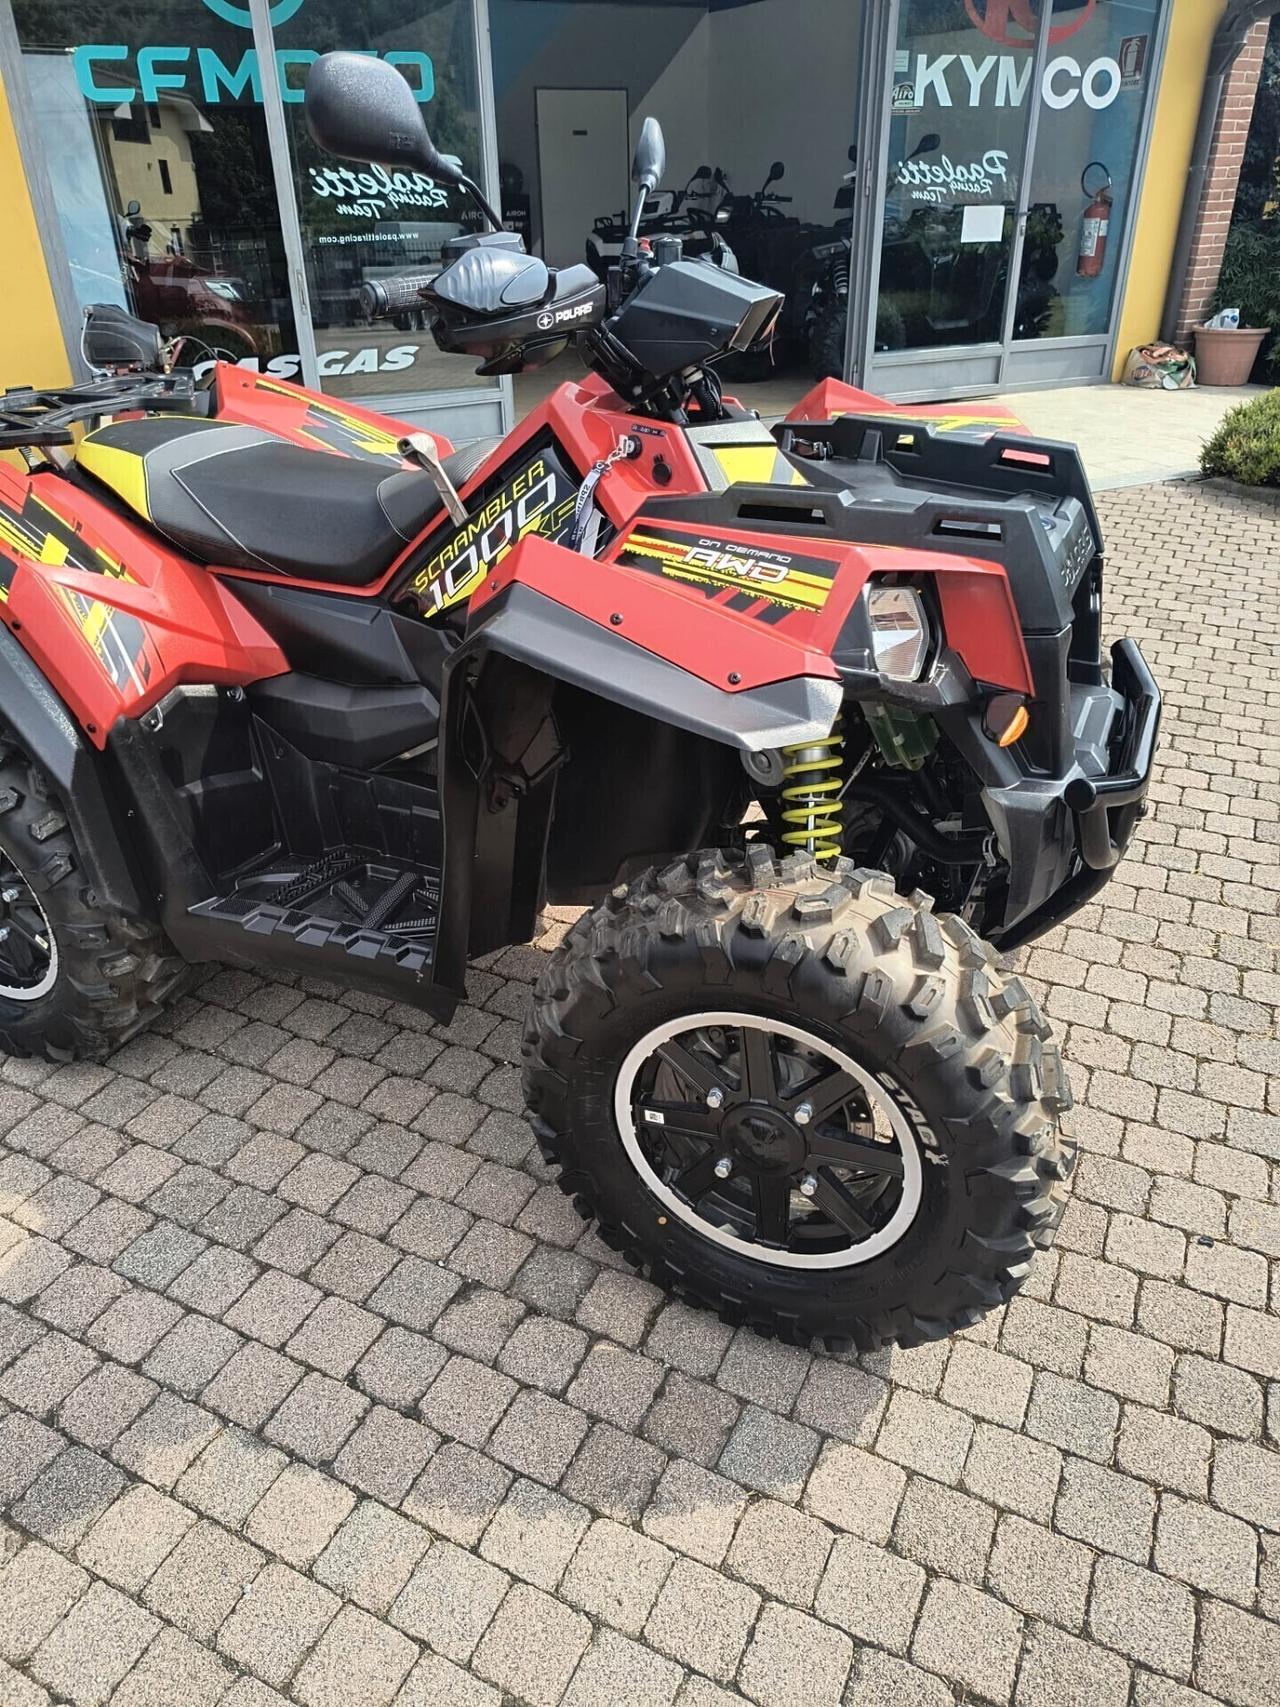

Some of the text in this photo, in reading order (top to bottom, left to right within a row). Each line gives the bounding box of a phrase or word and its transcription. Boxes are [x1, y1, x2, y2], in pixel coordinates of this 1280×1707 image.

[73, 45, 434, 103] CFMOO
[914, 54, 1121, 109] KYMCO
[555, 301, 593, 323] POLARIS
[415, 459, 545, 593] SCRAMBLER
[428, 472, 557, 611] 1000
[698, 538, 792, 564] ON DEMAND
[682, 547, 790, 584] AWD
[875, 1071, 938, 1147] STAG
